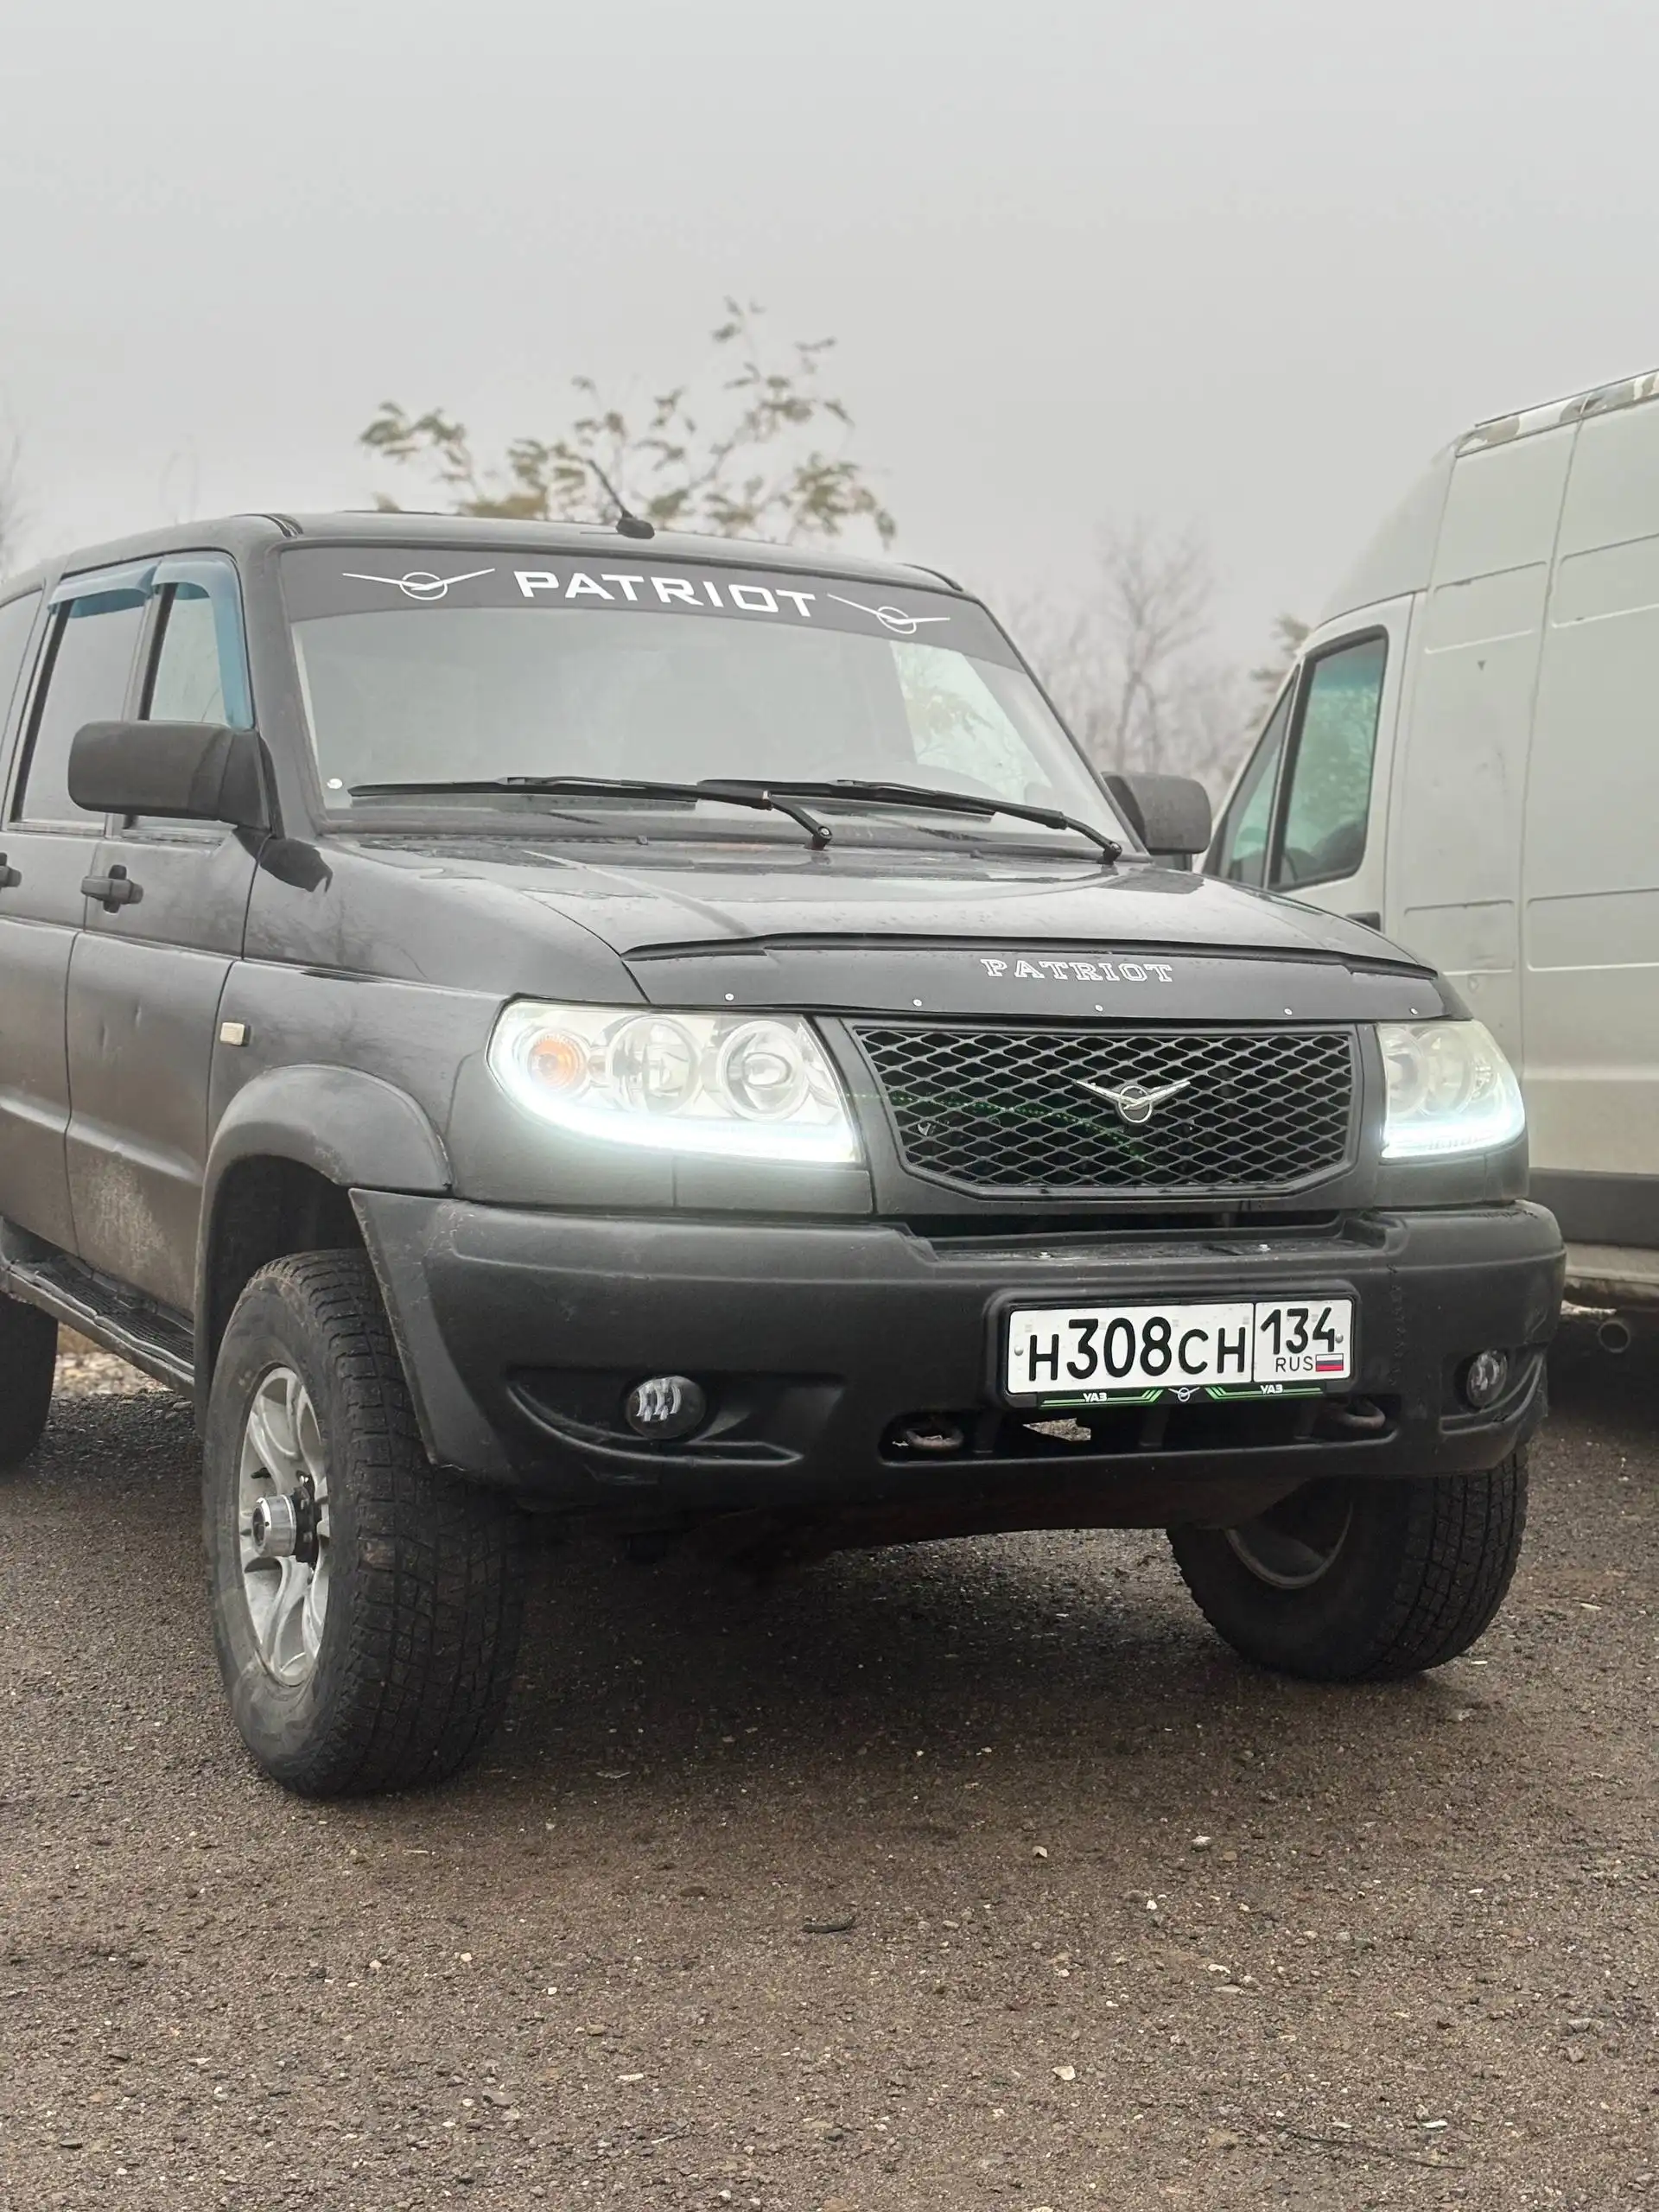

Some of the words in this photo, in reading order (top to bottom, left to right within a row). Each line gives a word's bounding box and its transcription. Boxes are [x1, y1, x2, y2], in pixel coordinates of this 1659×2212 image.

[513, 570, 815, 617] PATRIOT
[980, 958, 1173, 982] PATRIOT
[1260, 1306, 1335, 1355] 134
[1274, 1357, 1313, 1373] RUS
